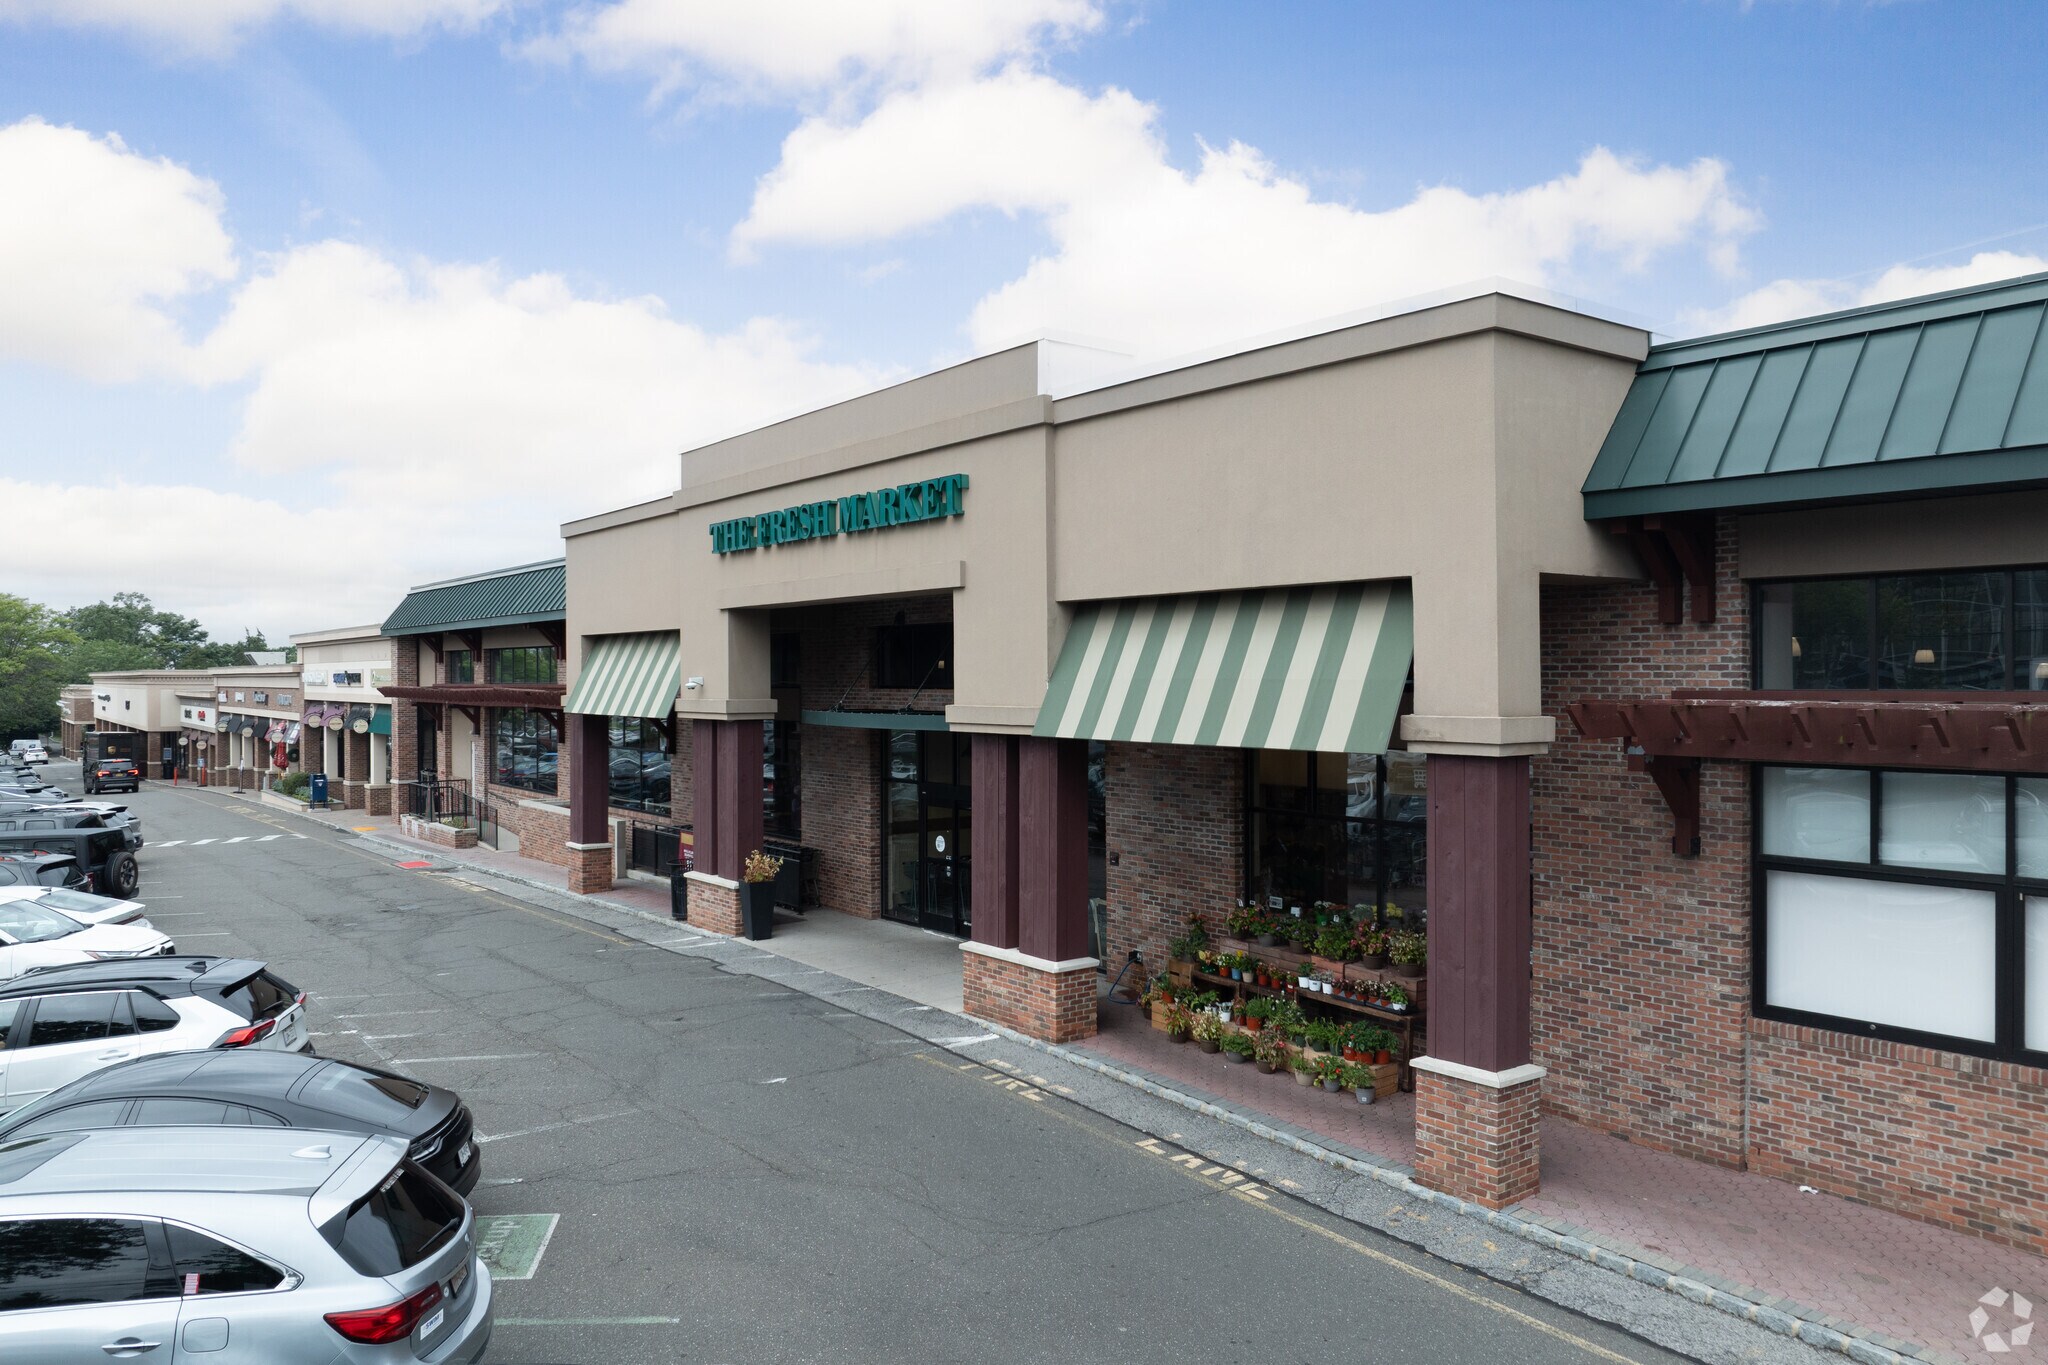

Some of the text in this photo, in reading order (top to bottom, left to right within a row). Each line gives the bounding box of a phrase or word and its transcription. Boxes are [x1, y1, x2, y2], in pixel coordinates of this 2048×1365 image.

[709, 473, 969, 554] THE FRESH MARKET
